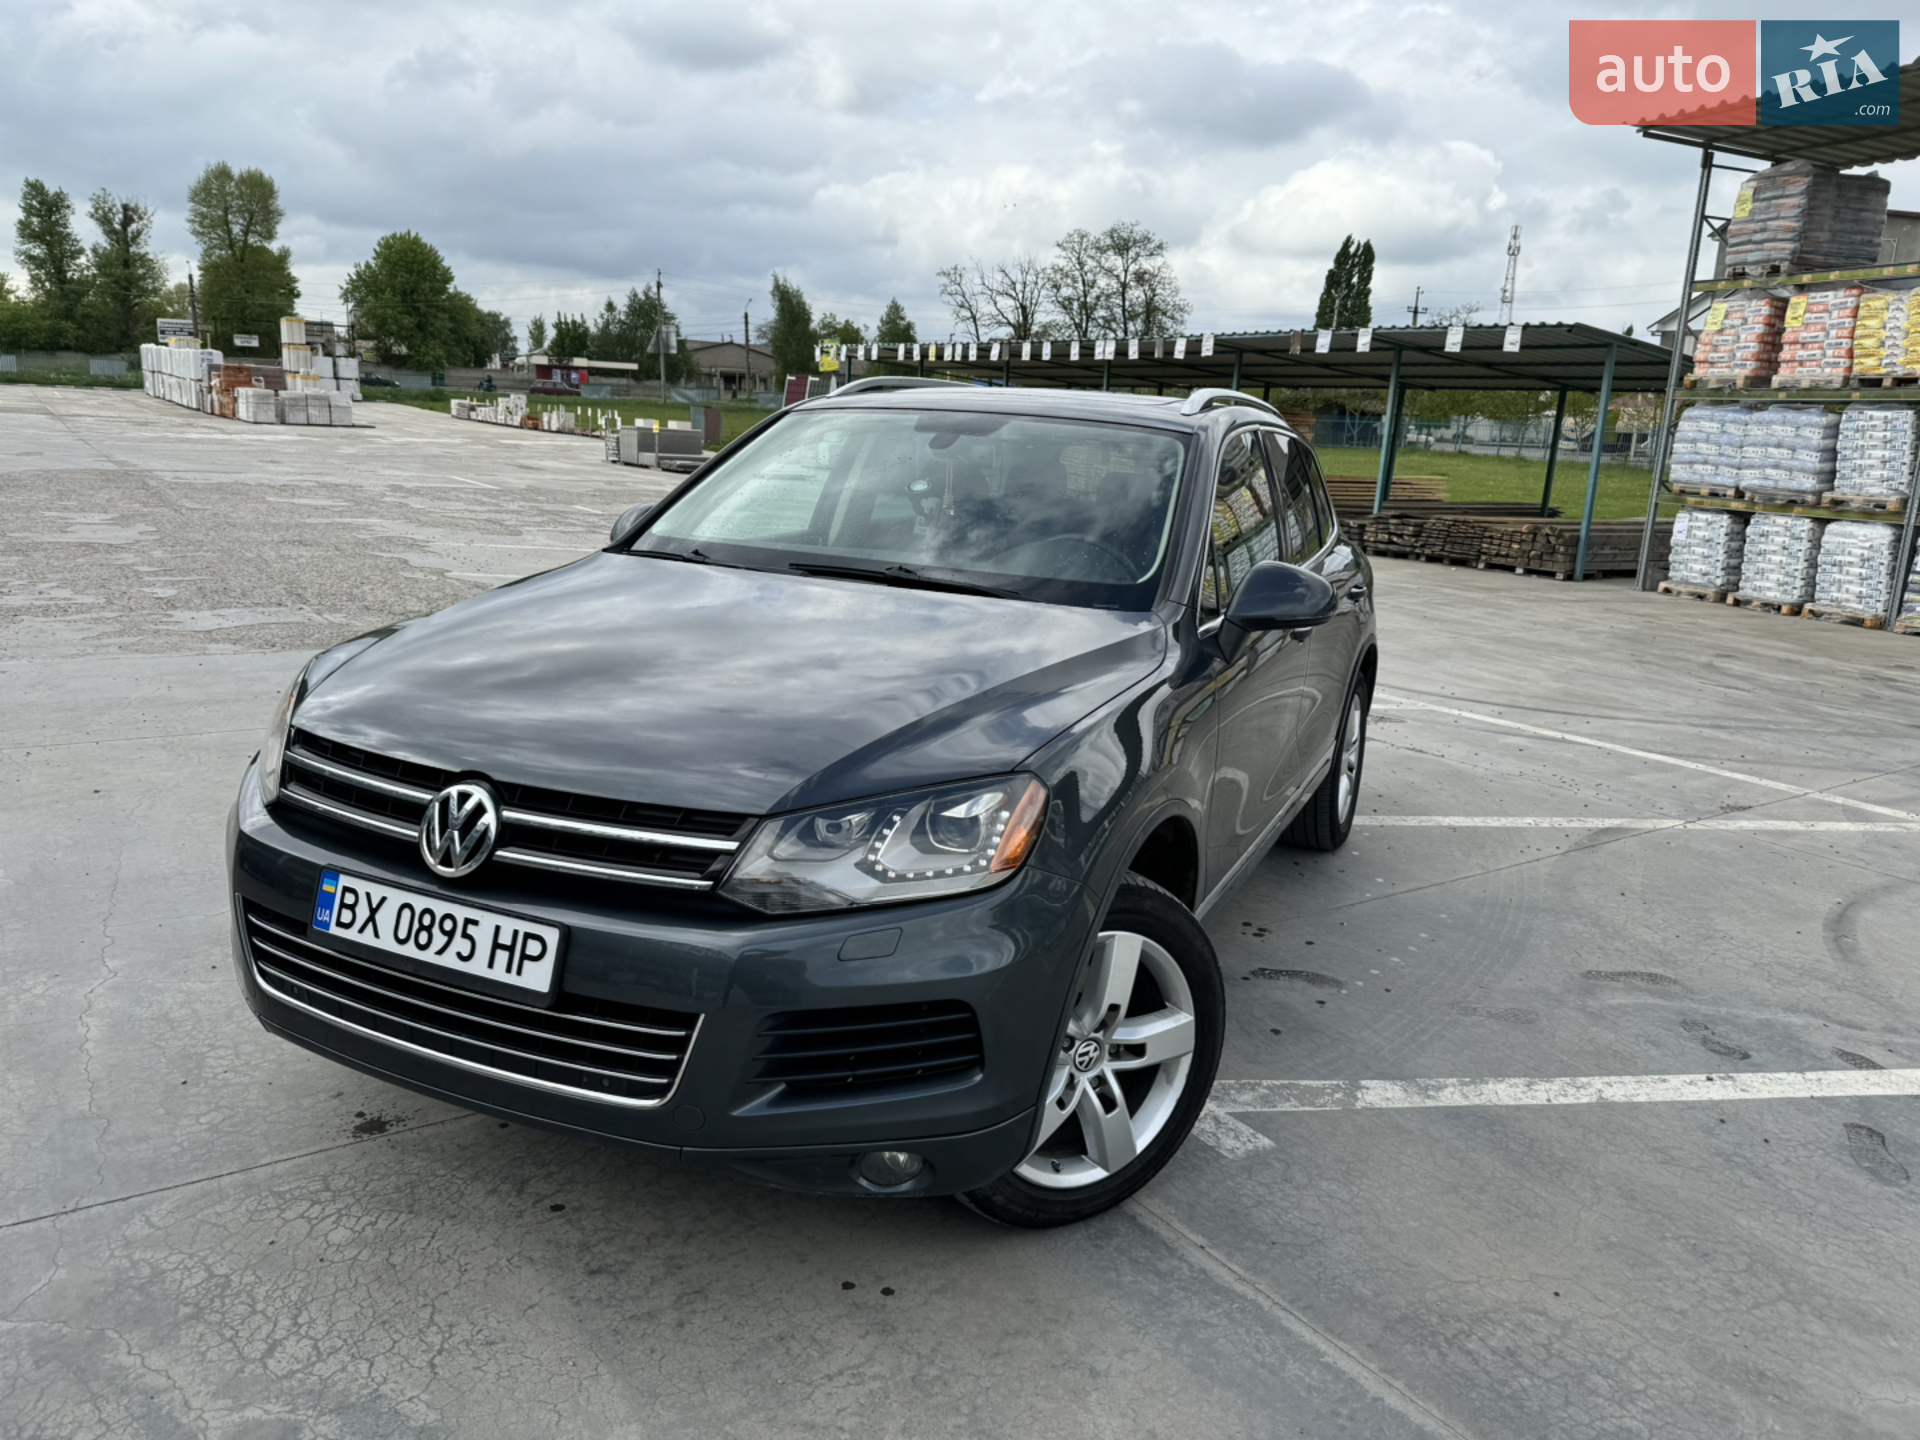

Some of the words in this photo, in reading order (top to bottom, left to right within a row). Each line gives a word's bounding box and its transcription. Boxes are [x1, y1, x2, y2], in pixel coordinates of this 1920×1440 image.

[316, 906, 331, 924] UA
[335, 885, 388, 939] BX
[393, 902, 480, 962] 0895
[487, 925, 548, 977] HP
